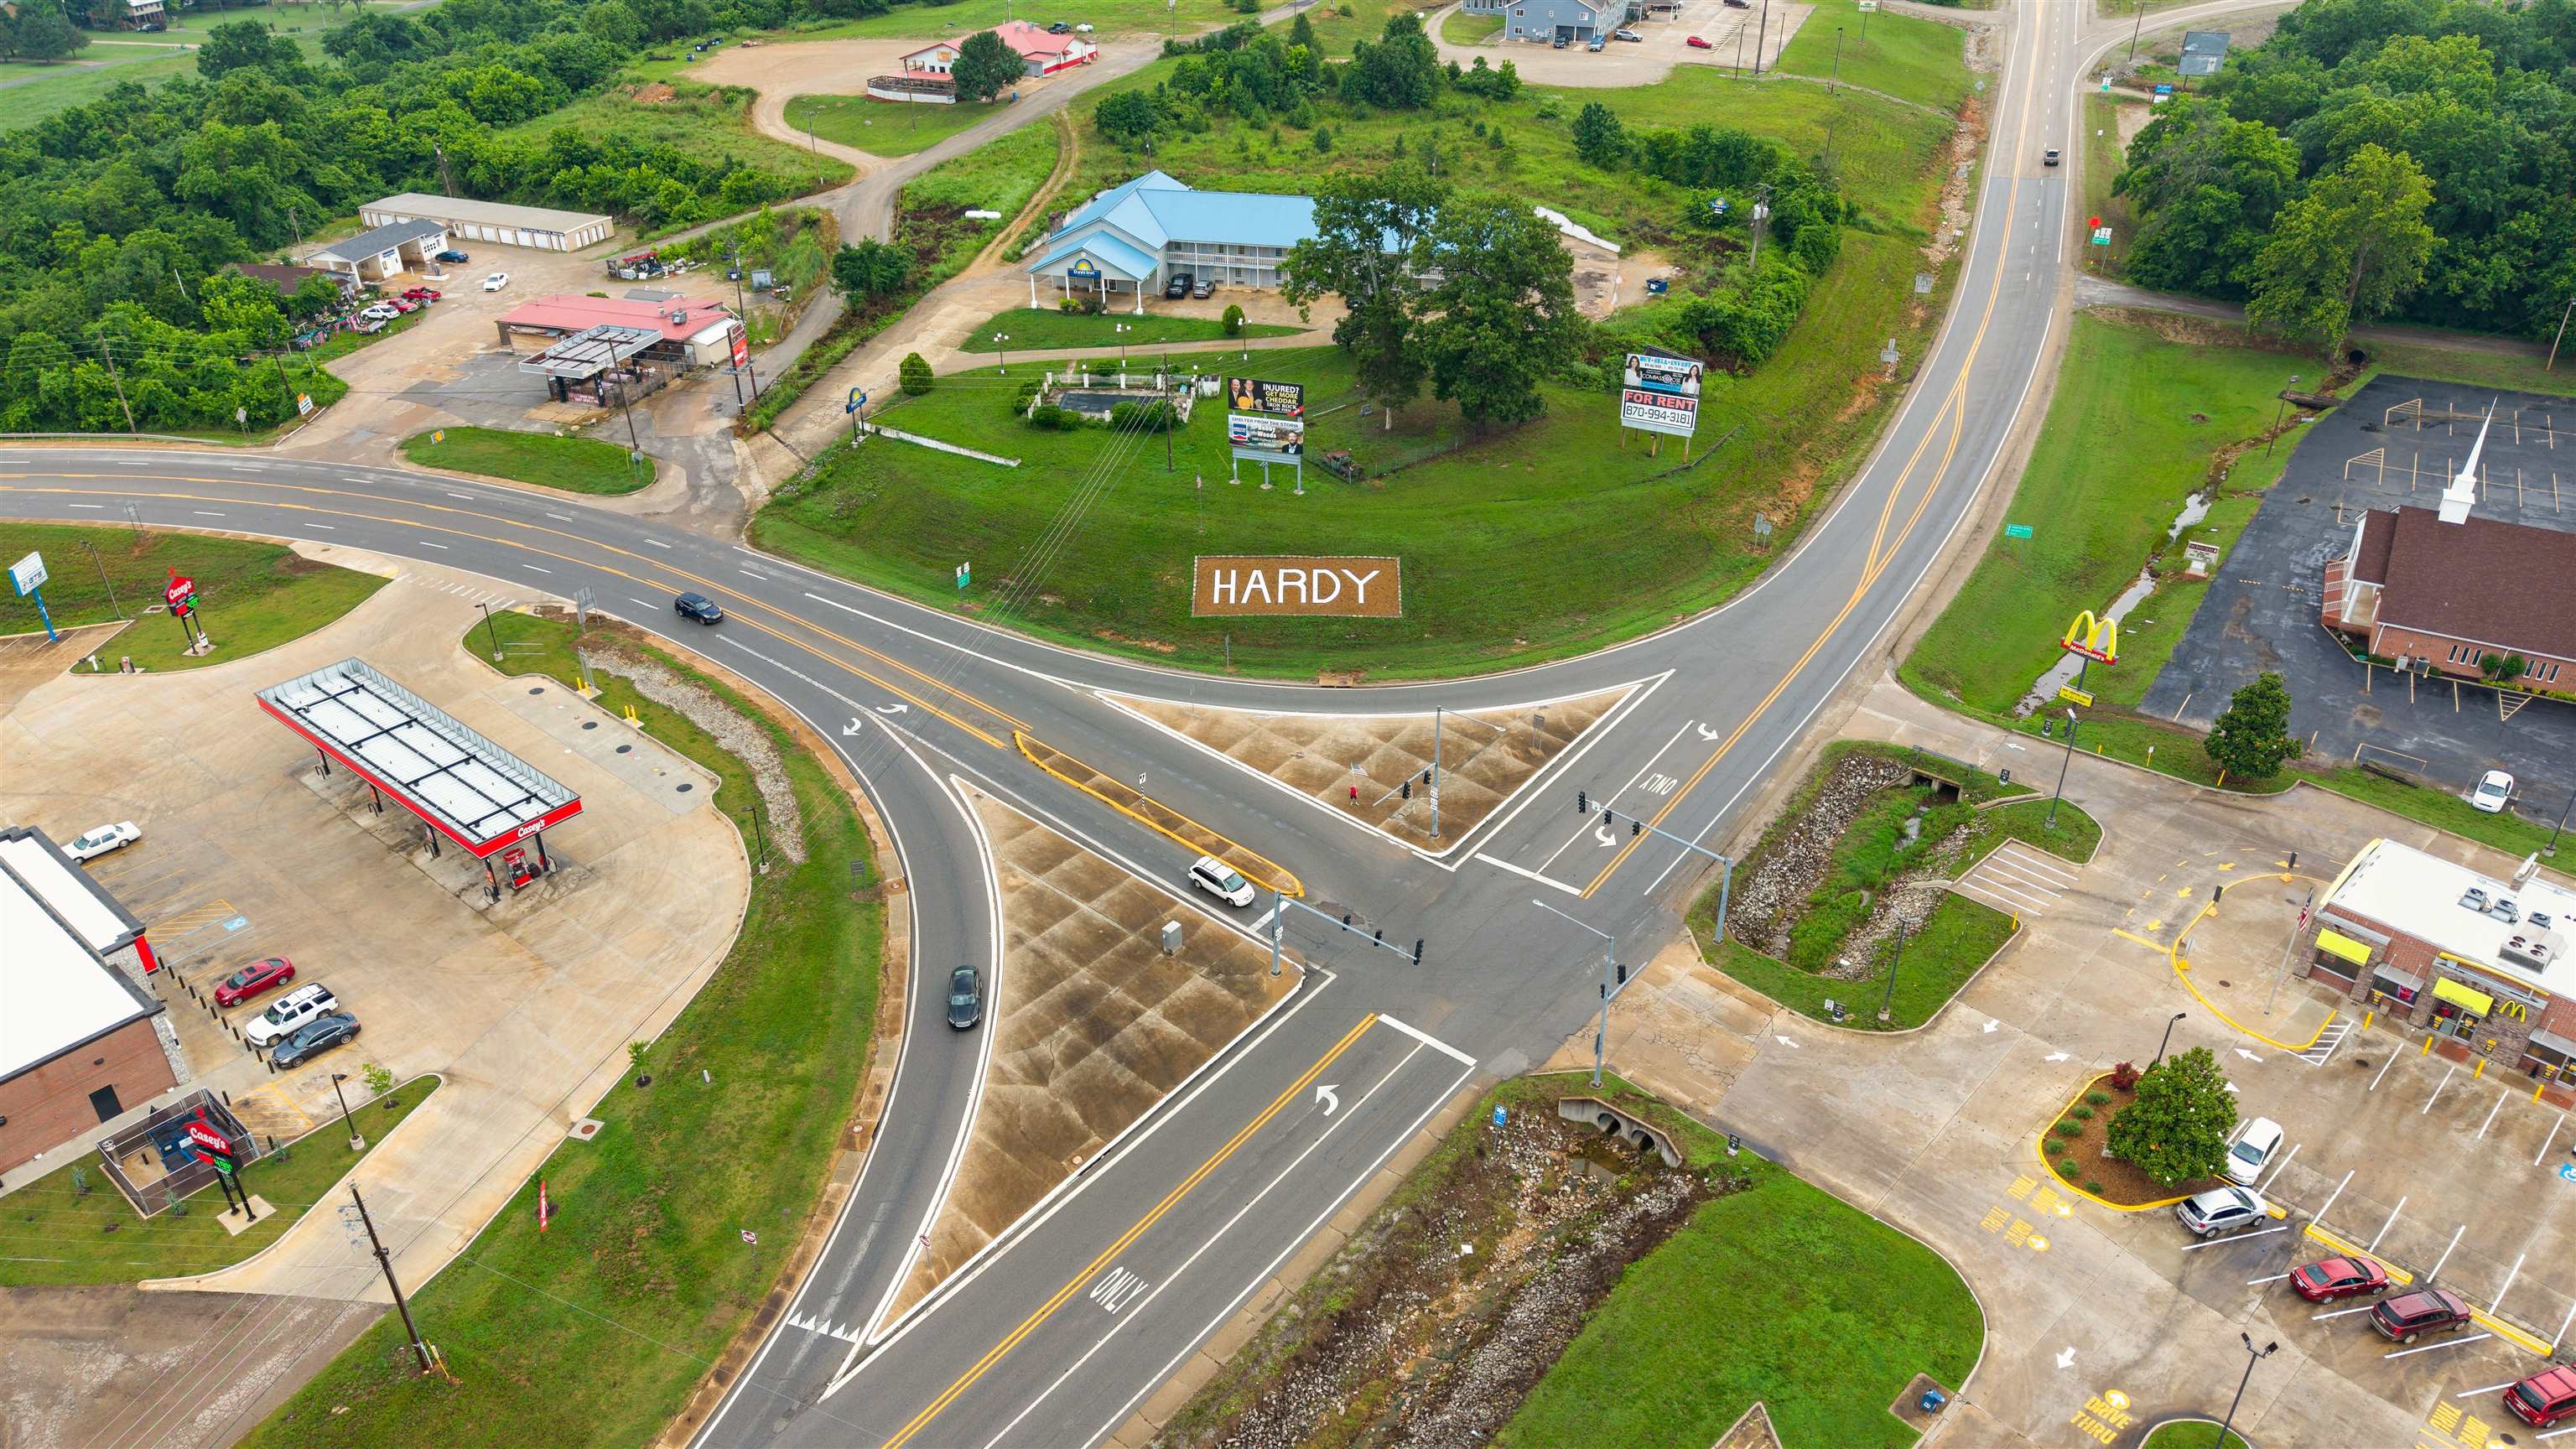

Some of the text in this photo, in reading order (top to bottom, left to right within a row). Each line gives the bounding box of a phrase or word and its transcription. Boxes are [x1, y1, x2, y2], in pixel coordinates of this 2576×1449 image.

[1263, 383, 1300, 394] INJURED?
[1279, 392, 1298, 400] MORE
[1625, 391, 1696, 411] FOR RENT
[1626, 405, 1691, 425] 870-994-3181
[169, 580, 192, 600] Casey's
[1213, 569, 1381, 605] HARDY
[2069, 644, 2106, 662] McDonald's
[1639, 772, 1678, 796] ONLY
[517, 818, 545, 838] Casey's
[190, 1127, 226, 1150] Casey's
[1089, 1266, 1150, 1315] ONLY
[2085, 1395, 2133, 1430] DRIVE
[2070, 1410, 2118, 1444] THRU
